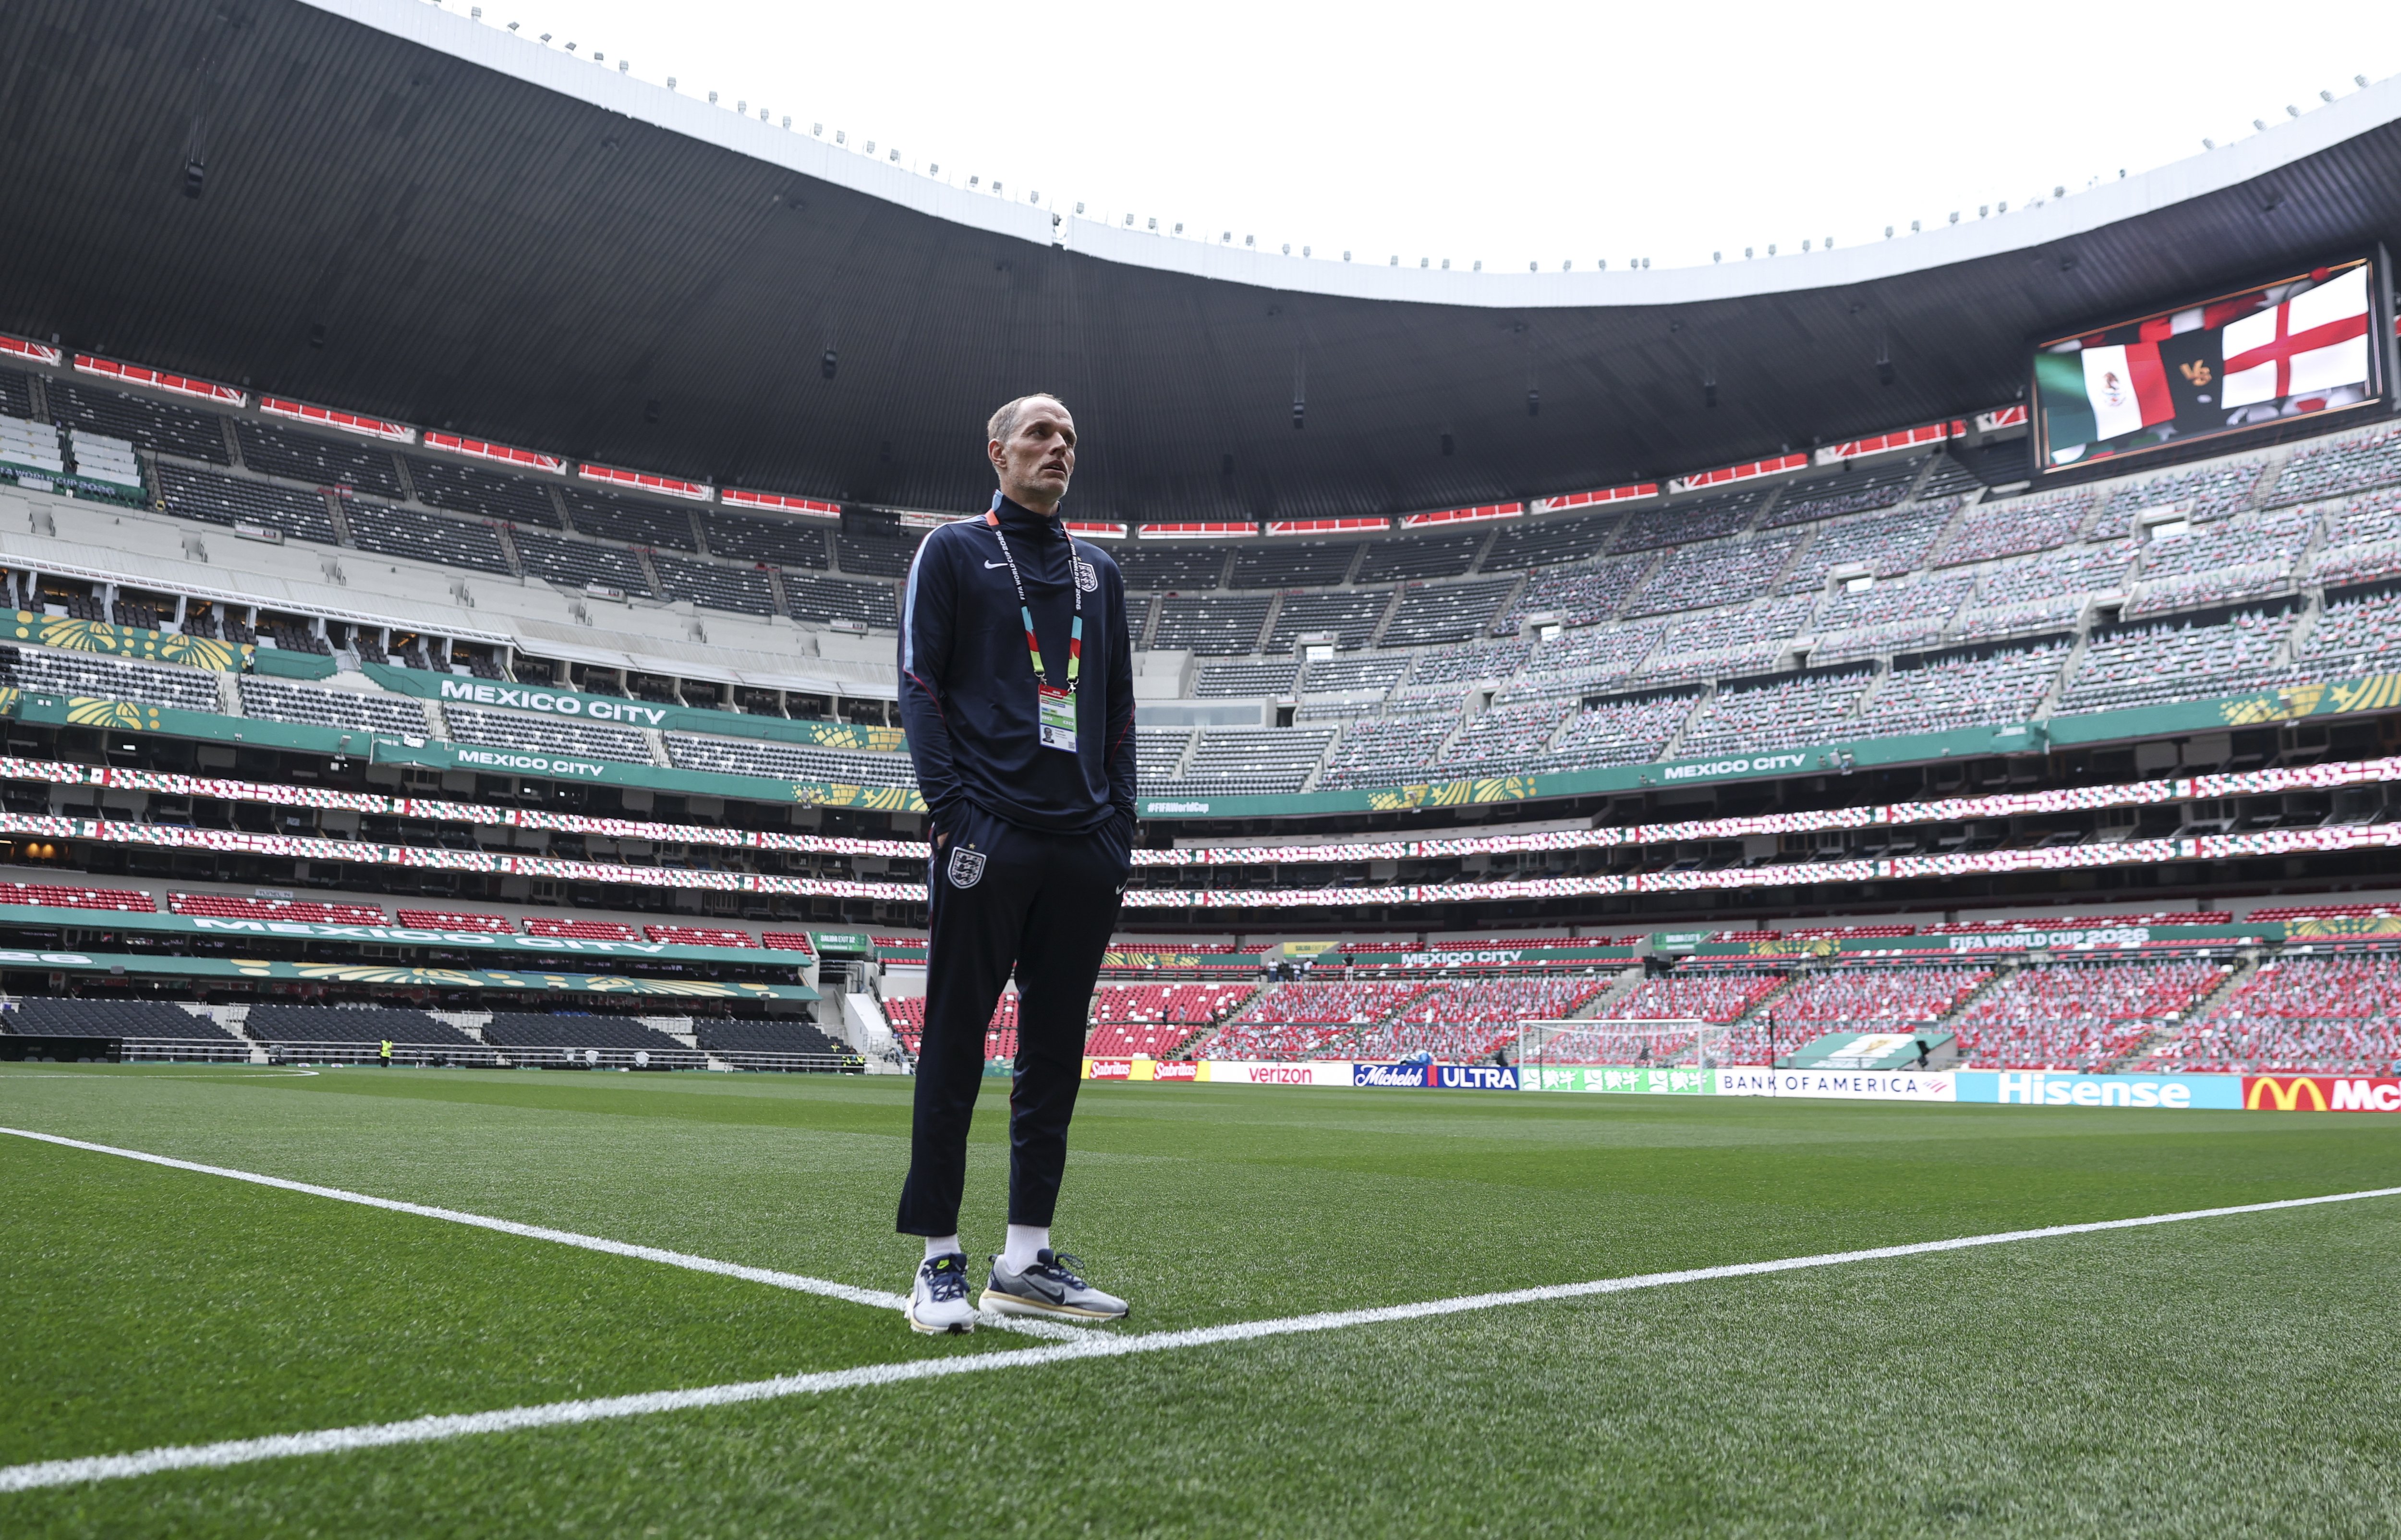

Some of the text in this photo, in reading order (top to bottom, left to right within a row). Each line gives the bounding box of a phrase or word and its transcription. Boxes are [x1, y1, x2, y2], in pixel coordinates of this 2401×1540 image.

[2179, 359, 2212, 386] VS
[995, 530, 1008, 551] 2026
[1004, 551, 1013, 562] CUP
[1009, 563, 1021, 585] WORLD
[441, 680, 666, 725] MEXICO CITY
[458, 750, 604, 776] MEXICO CITY
[1664, 753, 1806, 779] MEXICO CITY
[1147, 802, 1209, 813] #FIFAWorldCup
[193, 918, 665, 953] MEXICO CITY
[1949, 928, 2150, 949] FIFA WORLD CUP 2026
[1401, 950, 1522, 964] MEXICO CITY
[1090, 1061, 1130, 1079] Sabritas
[1154, 1062, 1197, 1080] Sabritas
[1249, 1063, 1312, 1084] verizon
[1355, 1065, 1517, 1089] Michelob ULTRA
[1542, 1069, 1576, 1091] 蒙牛
[1604, 1070, 1639, 1091] 蒙牛
[1724, 1076, 1918, 1092] BANK OF AMERICA
[1998, 1073, 2191, 1109] Hisense
[2331, 1079, 2401, 1111] Mc
